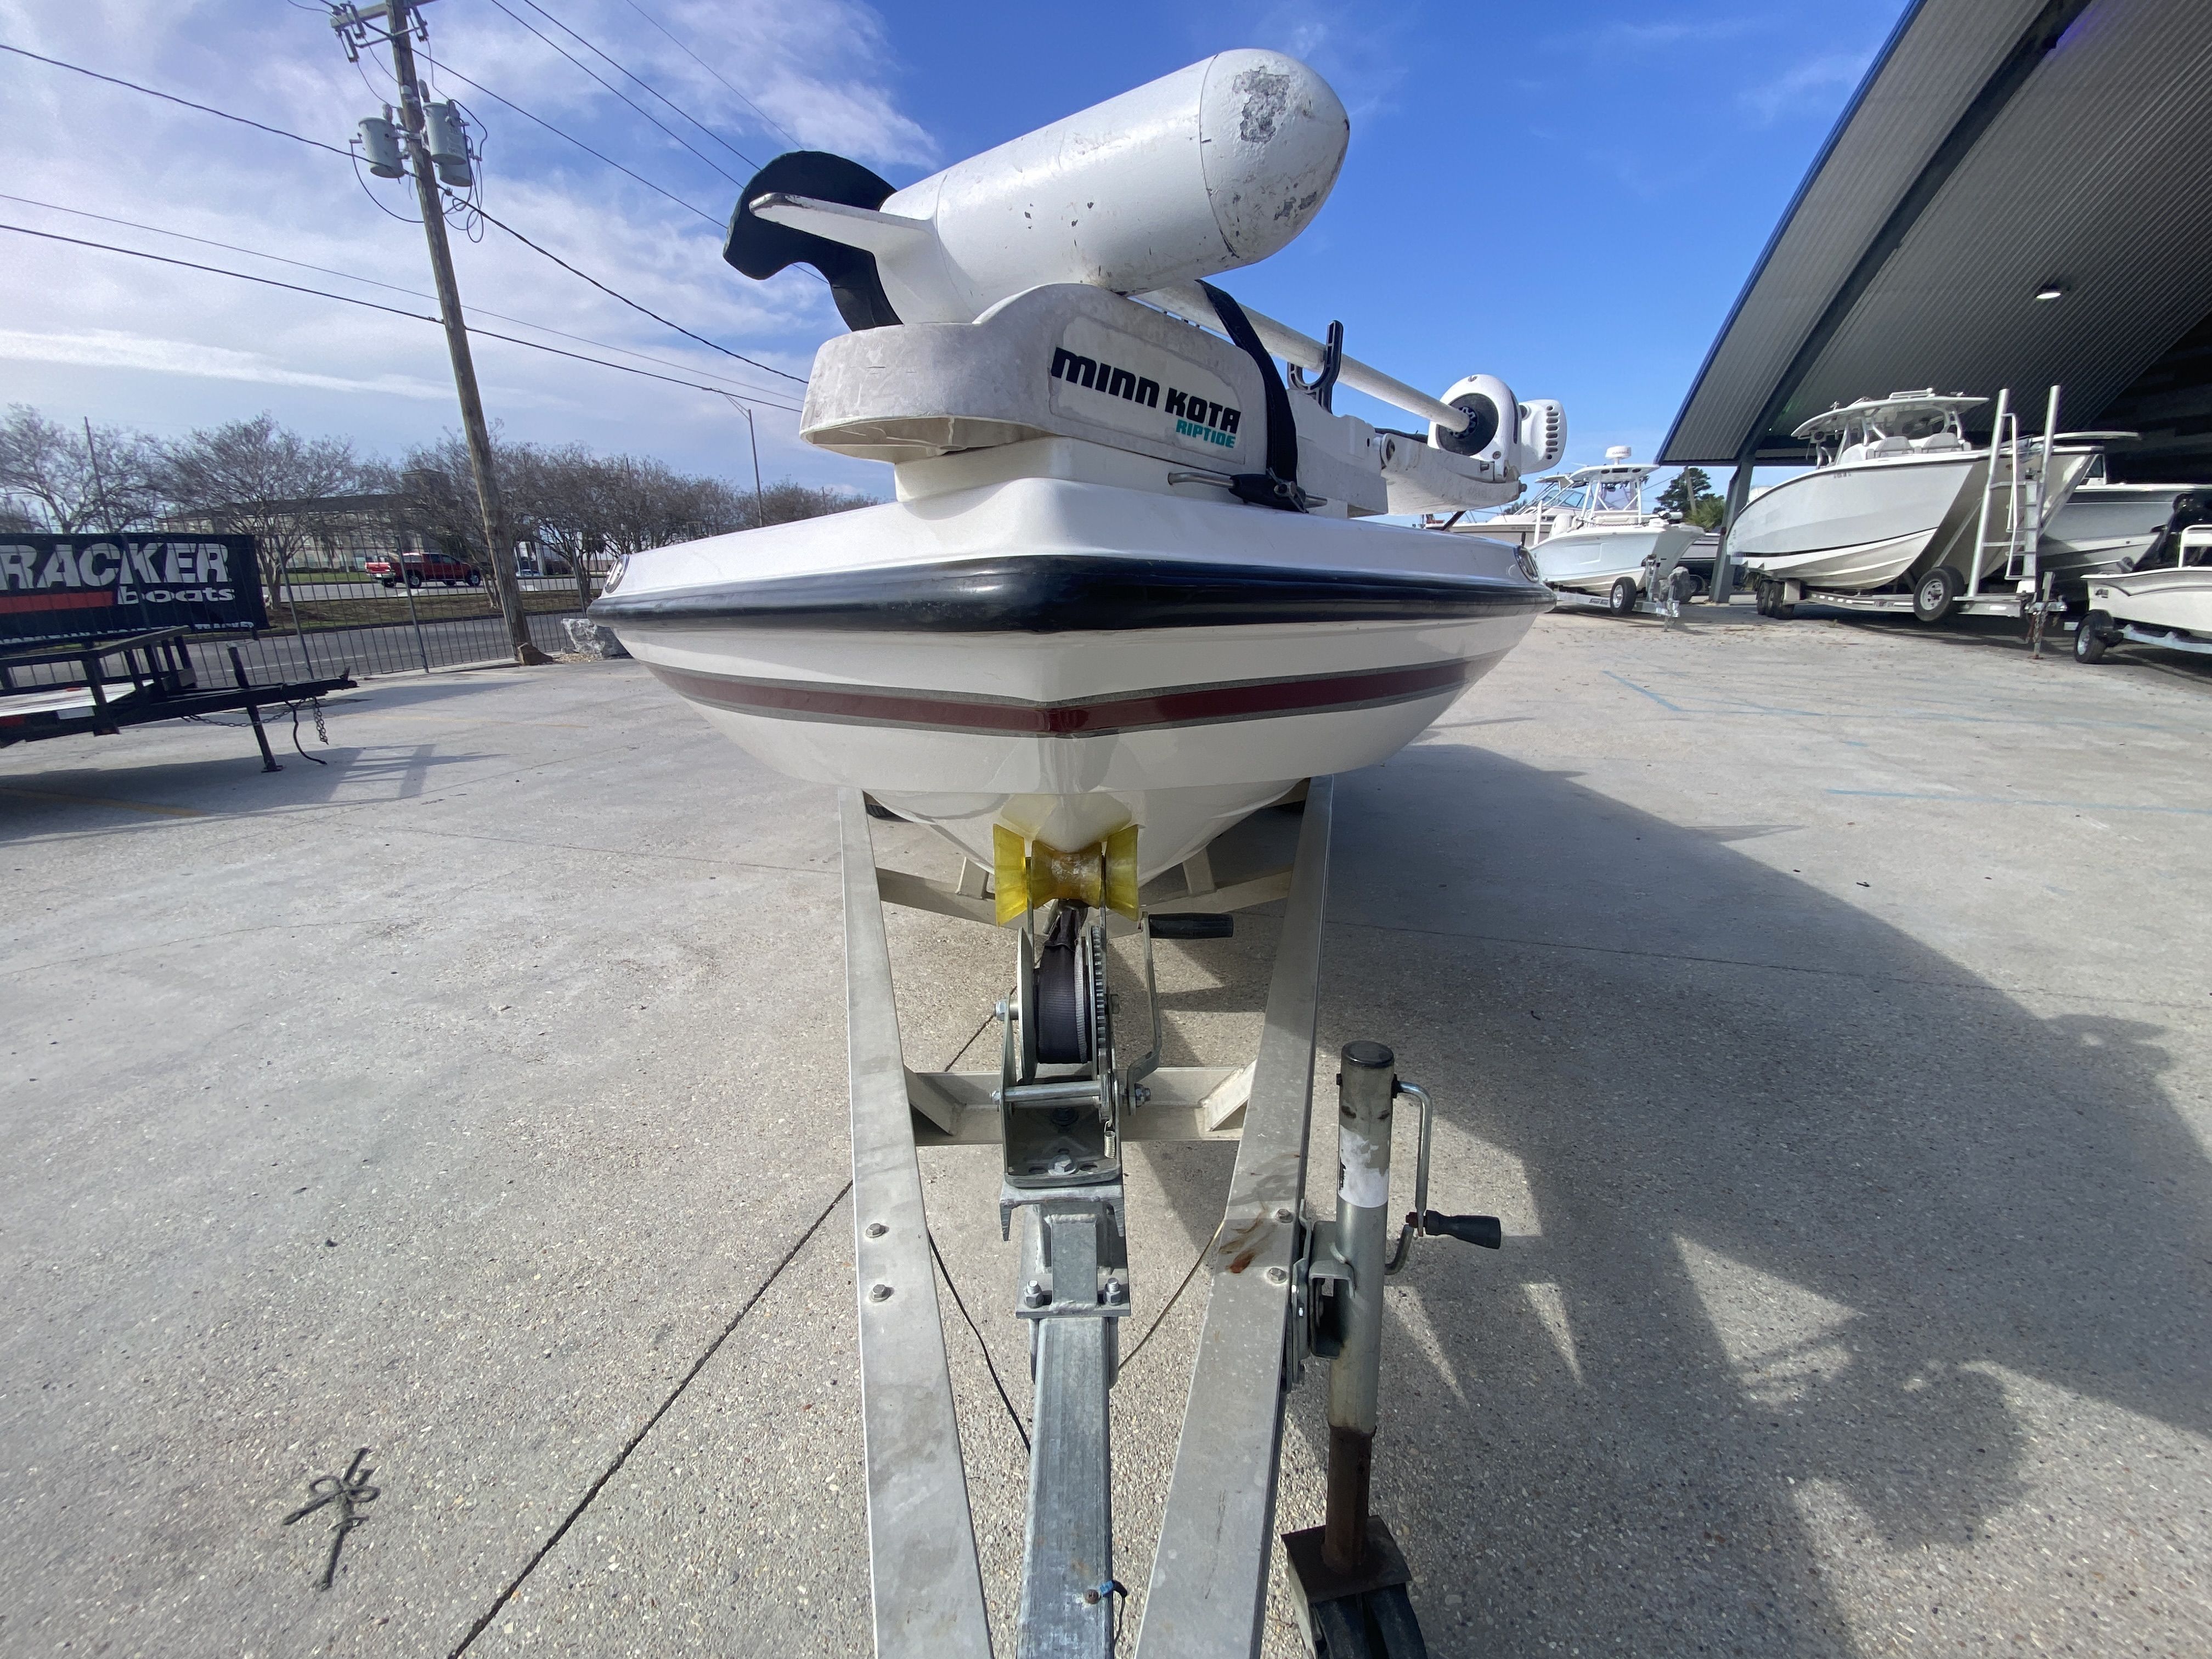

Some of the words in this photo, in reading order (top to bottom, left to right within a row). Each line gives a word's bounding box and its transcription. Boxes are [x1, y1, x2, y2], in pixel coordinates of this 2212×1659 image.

[1165, 387, 1241, 433] KOTA
[1176, 419, 1236, 448] RIPTIDE
[118, 586, 235, 605] boats
